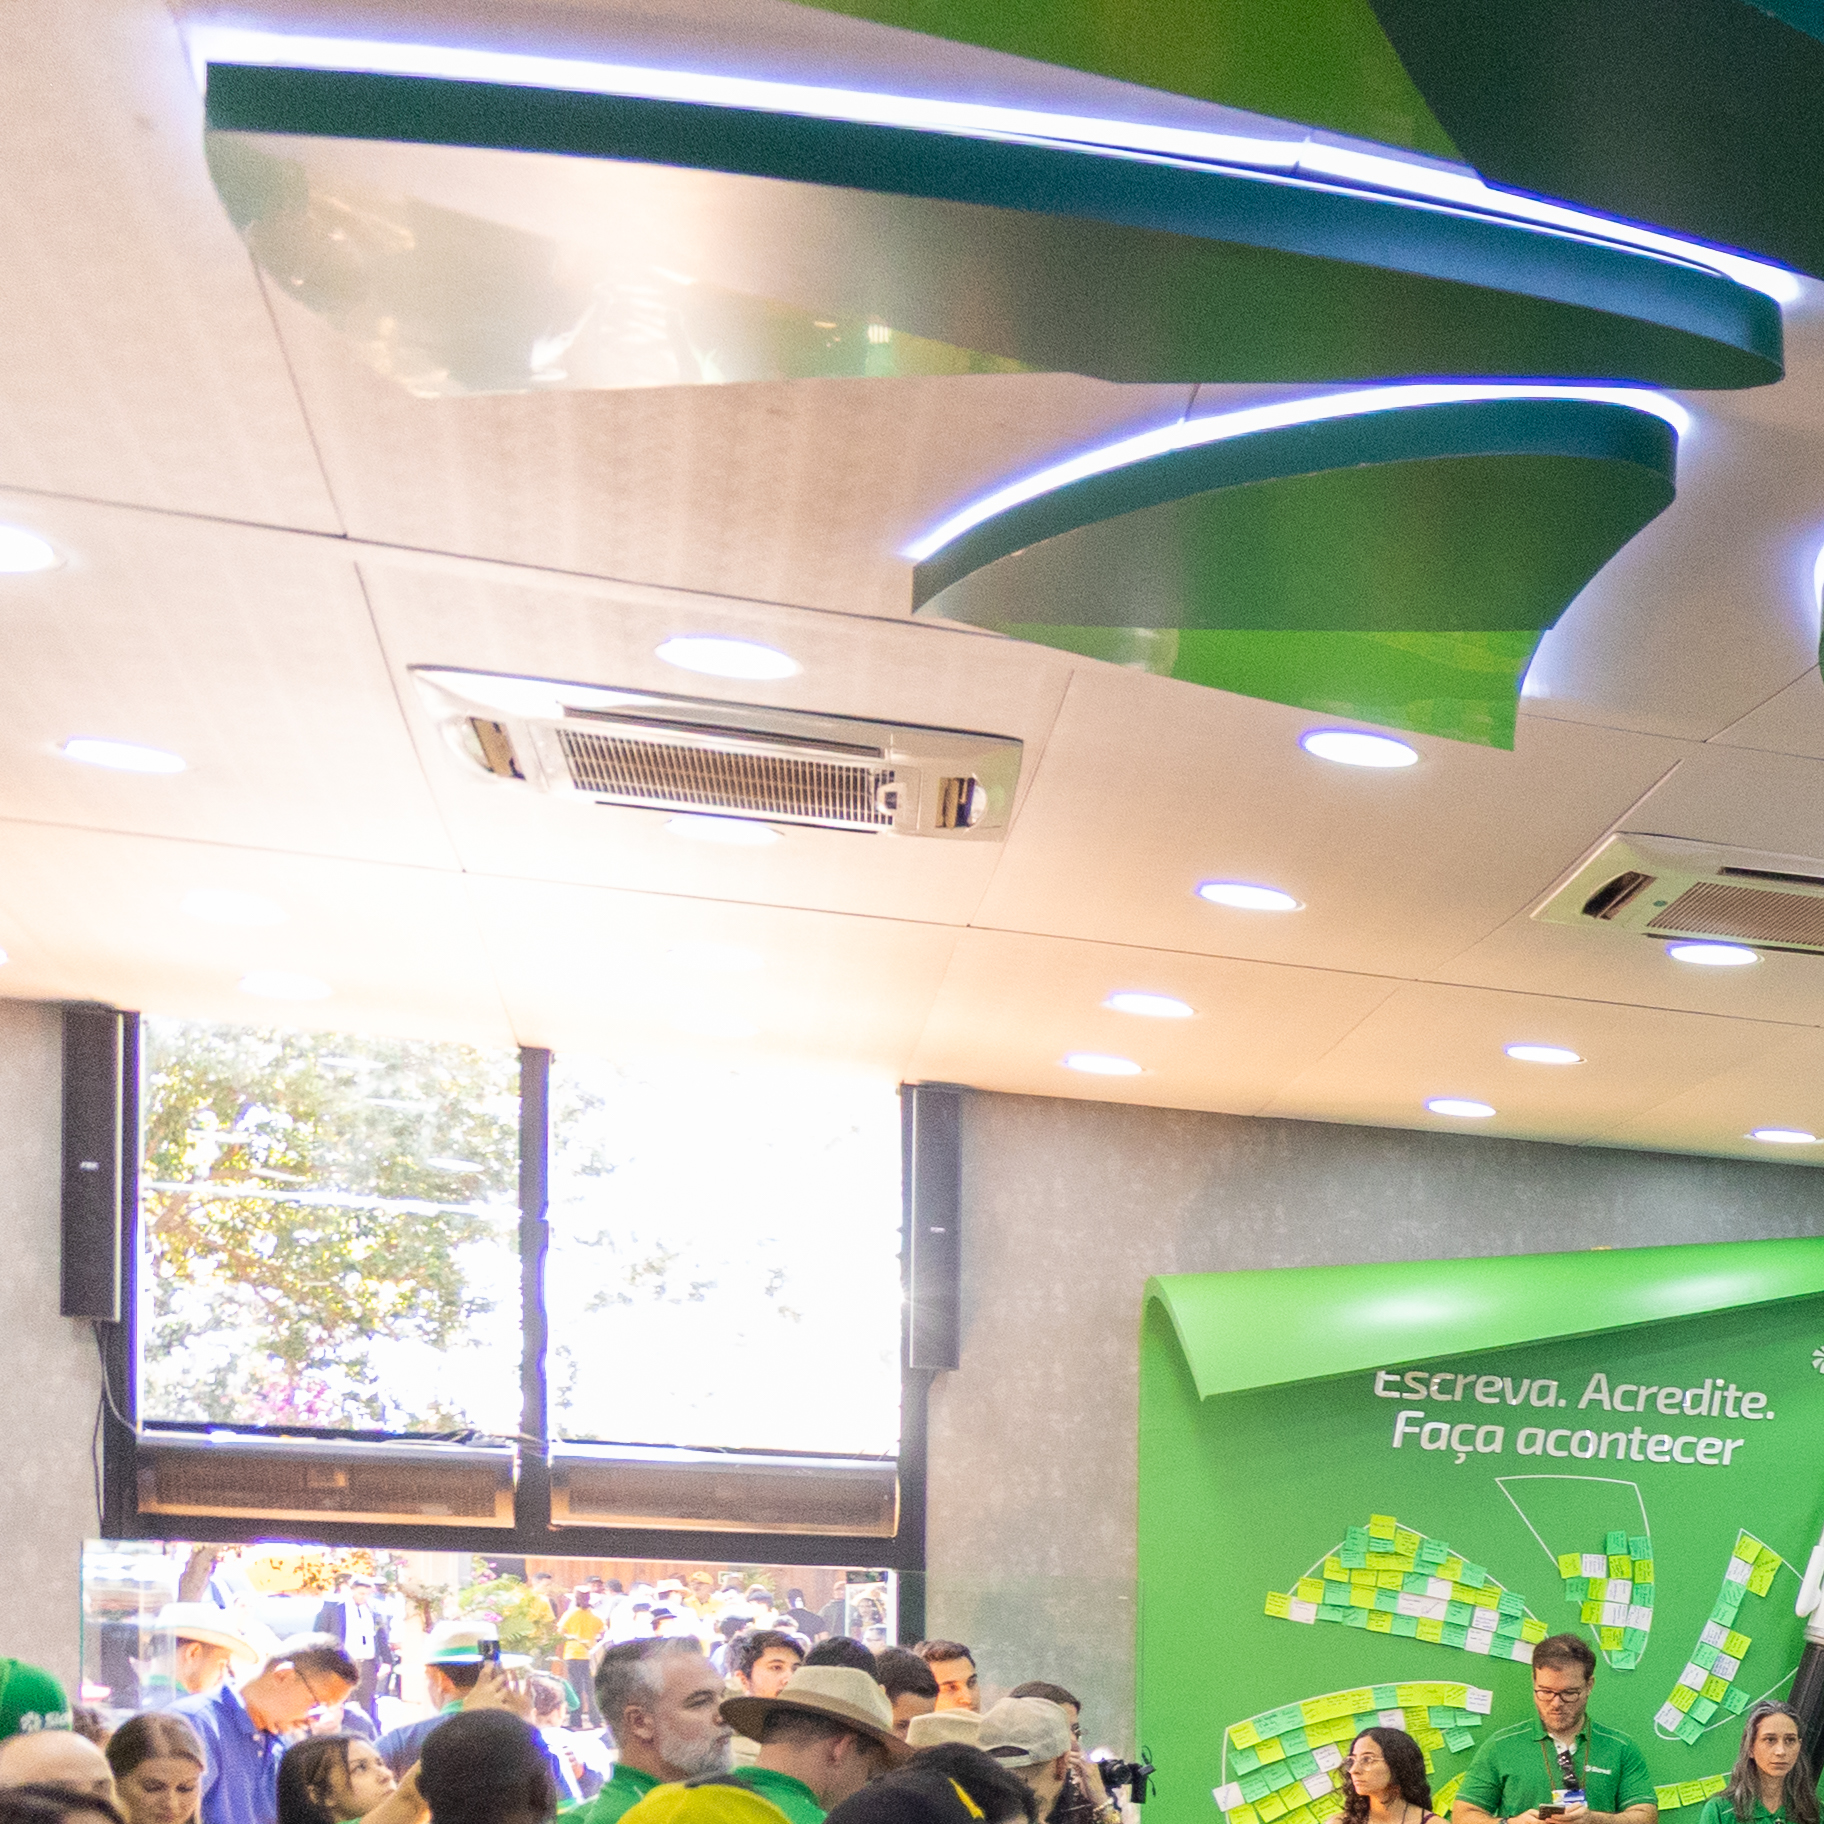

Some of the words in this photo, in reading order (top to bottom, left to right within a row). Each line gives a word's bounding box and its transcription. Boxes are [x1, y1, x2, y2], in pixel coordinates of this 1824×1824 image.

[1374, 1370, 1566, 1408] Escreva.
[1578, 1371, 1776, 1421] Acredite.
[1392, 1410, 1504, 1464] Faça
[1516, 1425, 1745, 1467] acontecer
